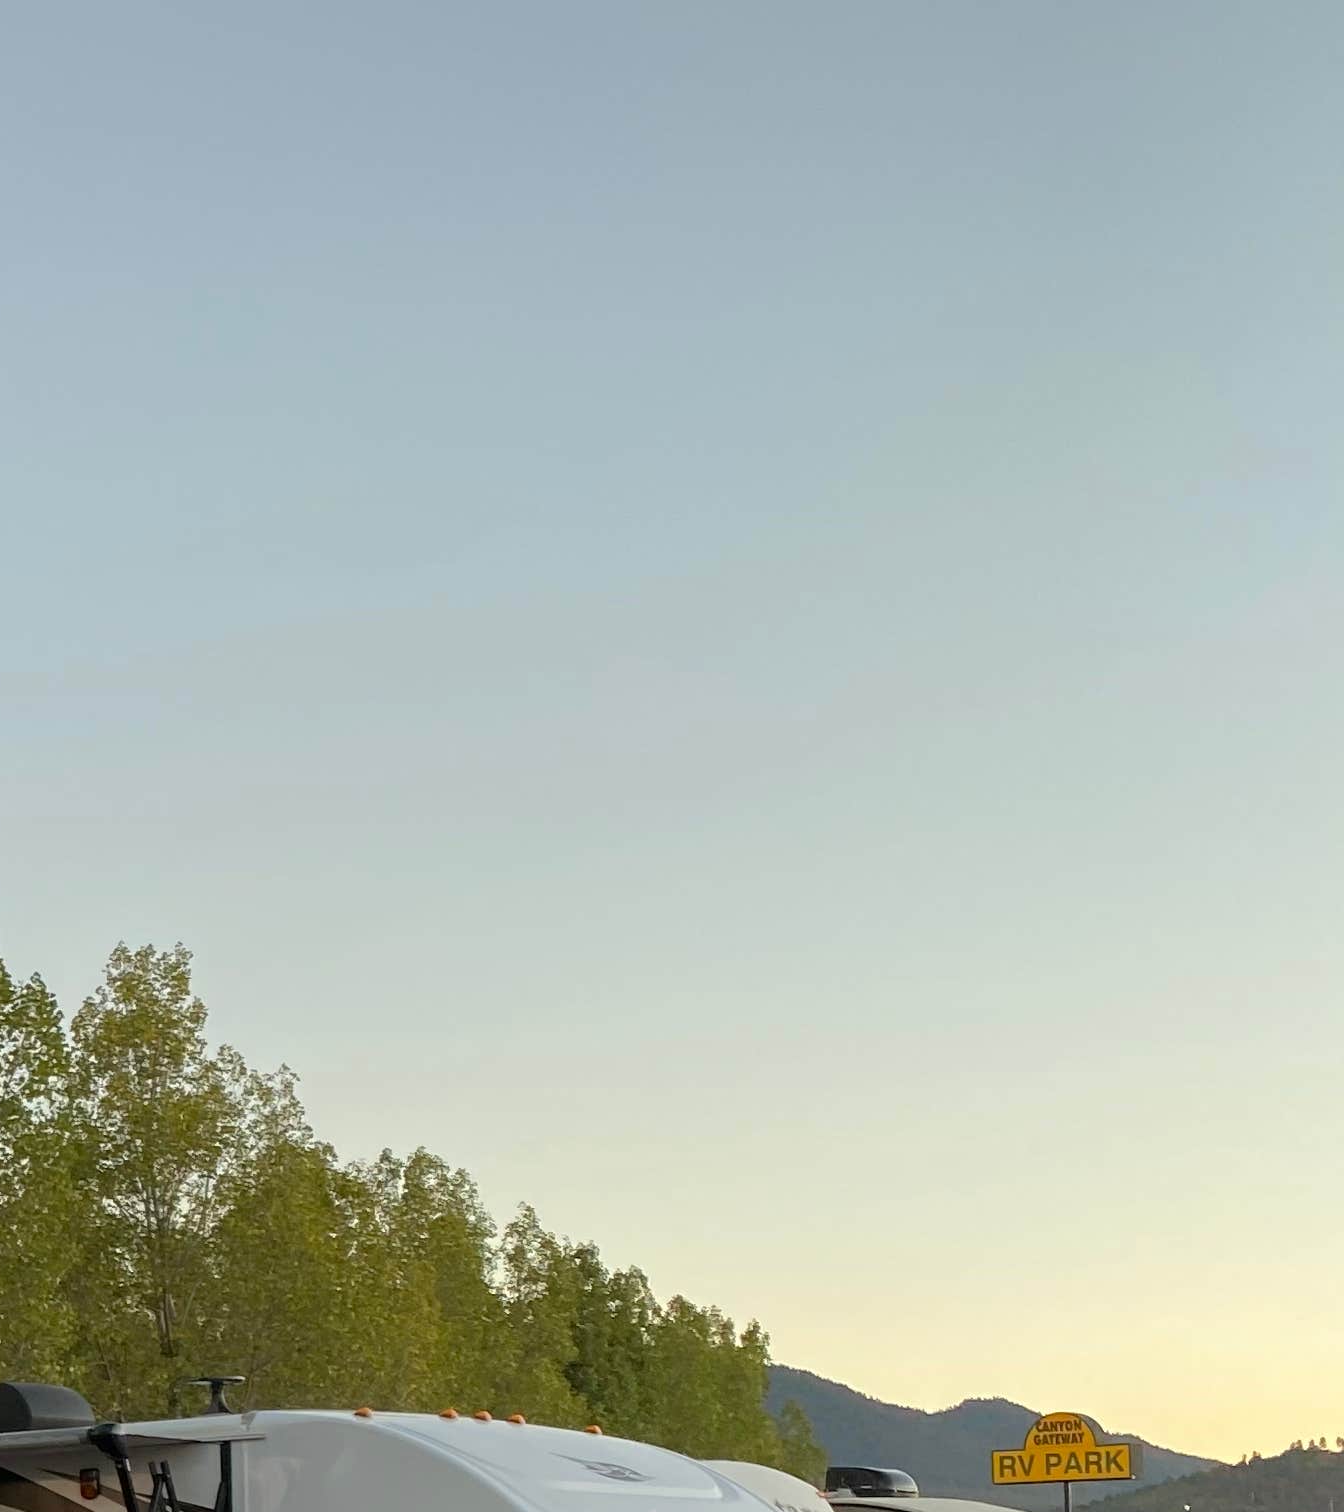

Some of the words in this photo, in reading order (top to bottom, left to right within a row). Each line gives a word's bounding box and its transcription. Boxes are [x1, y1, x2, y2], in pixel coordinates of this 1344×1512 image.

[1036, 1420, 1082, 1432] CANYON
[1034, 1432, 1084, 1445] GATEWAY
[999, 1454, 1035, 1478] RV
[1045, 1449, 1124, 1475] PARK
